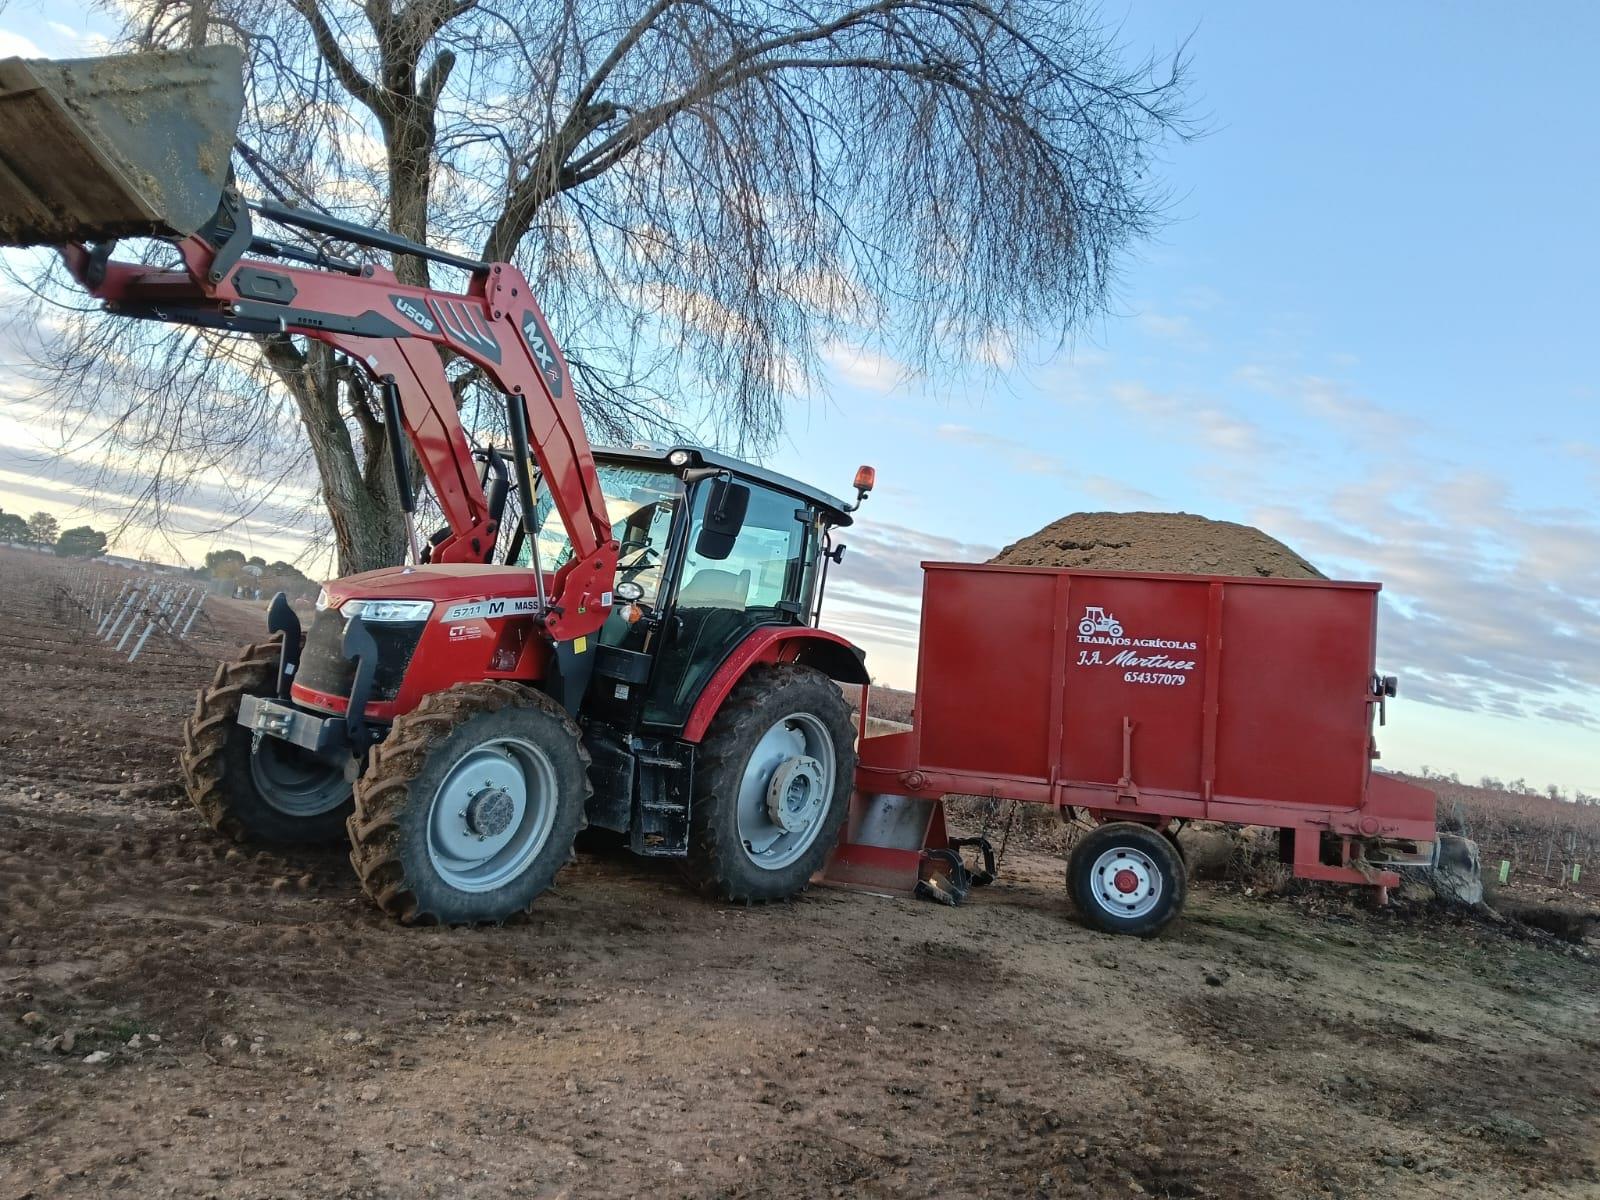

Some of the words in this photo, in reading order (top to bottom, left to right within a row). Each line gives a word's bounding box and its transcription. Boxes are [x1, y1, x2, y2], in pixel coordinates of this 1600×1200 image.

[396, 298, 434, 331] U508
[523, 321, 553, 369] MX
[453, 606, 481, 617] 5711
[489, 602, 504, 614] M
[1077, 635, 1131, 646] TRABAJOS
[1132, 639, 1197, 650] AGRÍCOLAS
[1076, 650, 1103, 665] J.A.
[1124, 671, 1186, 686] 654357079
